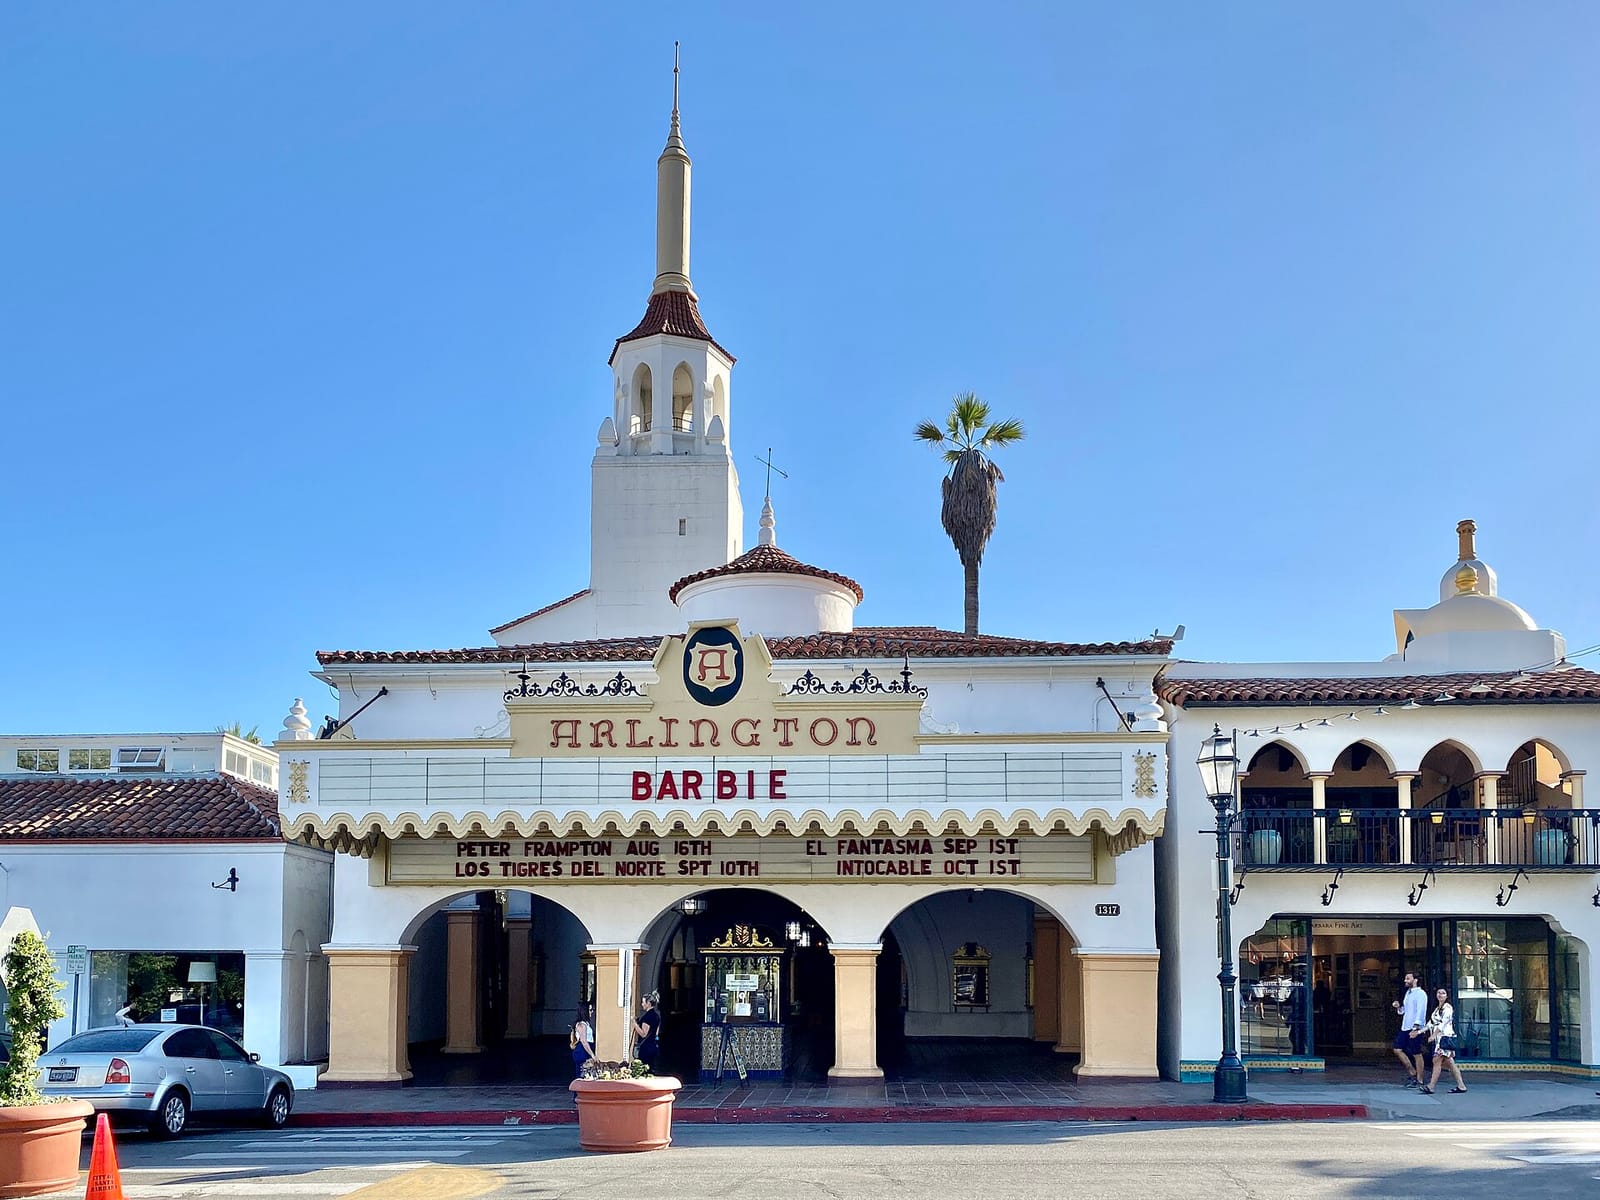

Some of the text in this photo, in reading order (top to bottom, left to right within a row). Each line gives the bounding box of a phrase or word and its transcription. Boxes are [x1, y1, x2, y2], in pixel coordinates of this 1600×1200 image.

[698, 649, 730, 681] A
[550, 717, 878, 749] ARLINGTON
[632, 770, 787, 801] BARBIE
[457, 841, 511, 857] PETER
[524, 841, 612, 857] FRAMPTON
[625, 840, 660, 856] AUG
[806, 840, 827, 856] EL
[837, 839, 933, 855] FANTASMA
[943, 838, 978, 855] SEP
[455, 861, 490, 877] LOS
[499, 861, 563, 877] TIGRES
[571, 861, 604, 877] DEL
[615, 861, 666, 876] NORTE
[677, 861, 711, 876] SPT
[836, 859, 932, 876] INTOCABLE
[943, 859, 979, 875] OCT
[1098, 905, 1117, 915] 1317
